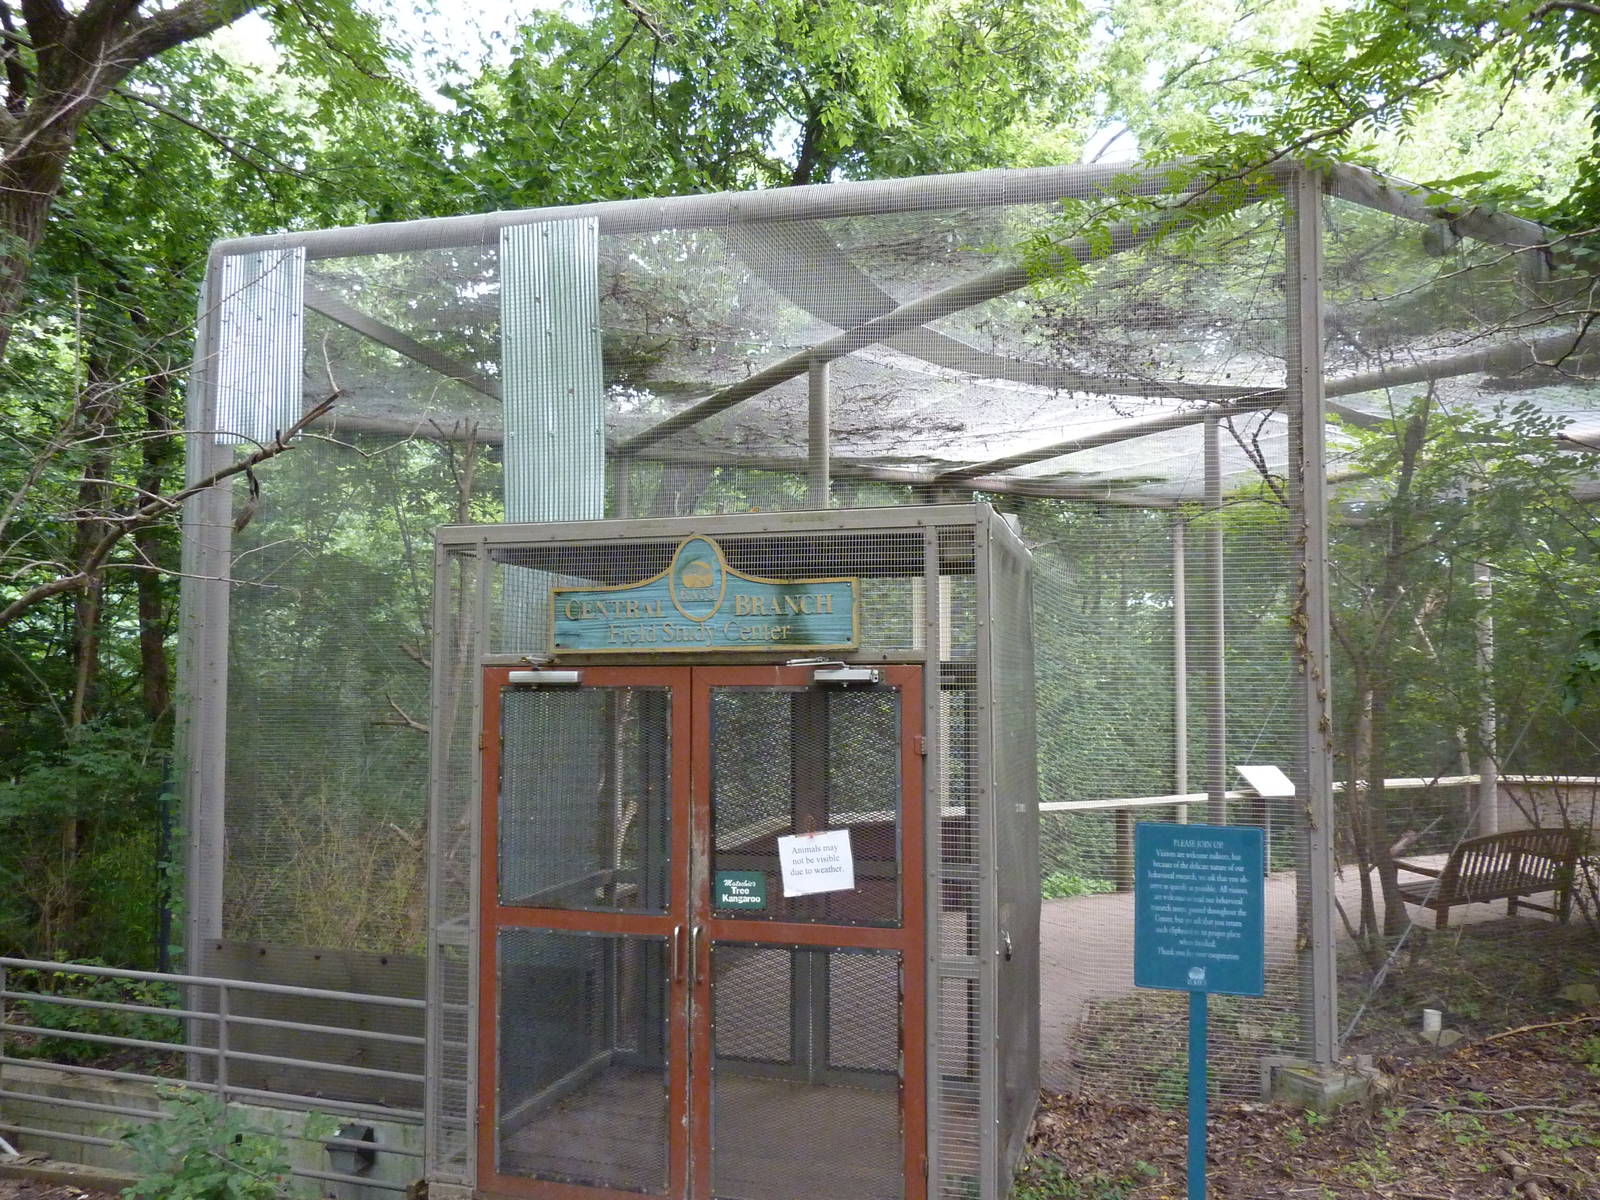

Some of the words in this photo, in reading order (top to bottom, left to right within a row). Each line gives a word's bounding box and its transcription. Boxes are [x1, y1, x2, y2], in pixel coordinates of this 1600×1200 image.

[564, 599, 664, 620] CENTRAL
[735, 593, 833, 617] BRANCH
[608, 623, 657, 645] Field
[662, 622, 716, 647] Study
[724, 620, 791, 641] Center
[1196, 840, 1213, 848] JOIN
[792, 845, 821, 854] Animals
[823, 844, 838, 852] may
[806, 856, 814, 864] be
[816, 855, 840, 863] visible
[1153, 860, 1172, 868] because
[1180, 861, 1188, 869] the
[722, 894, 761, 903] Kangaroo
